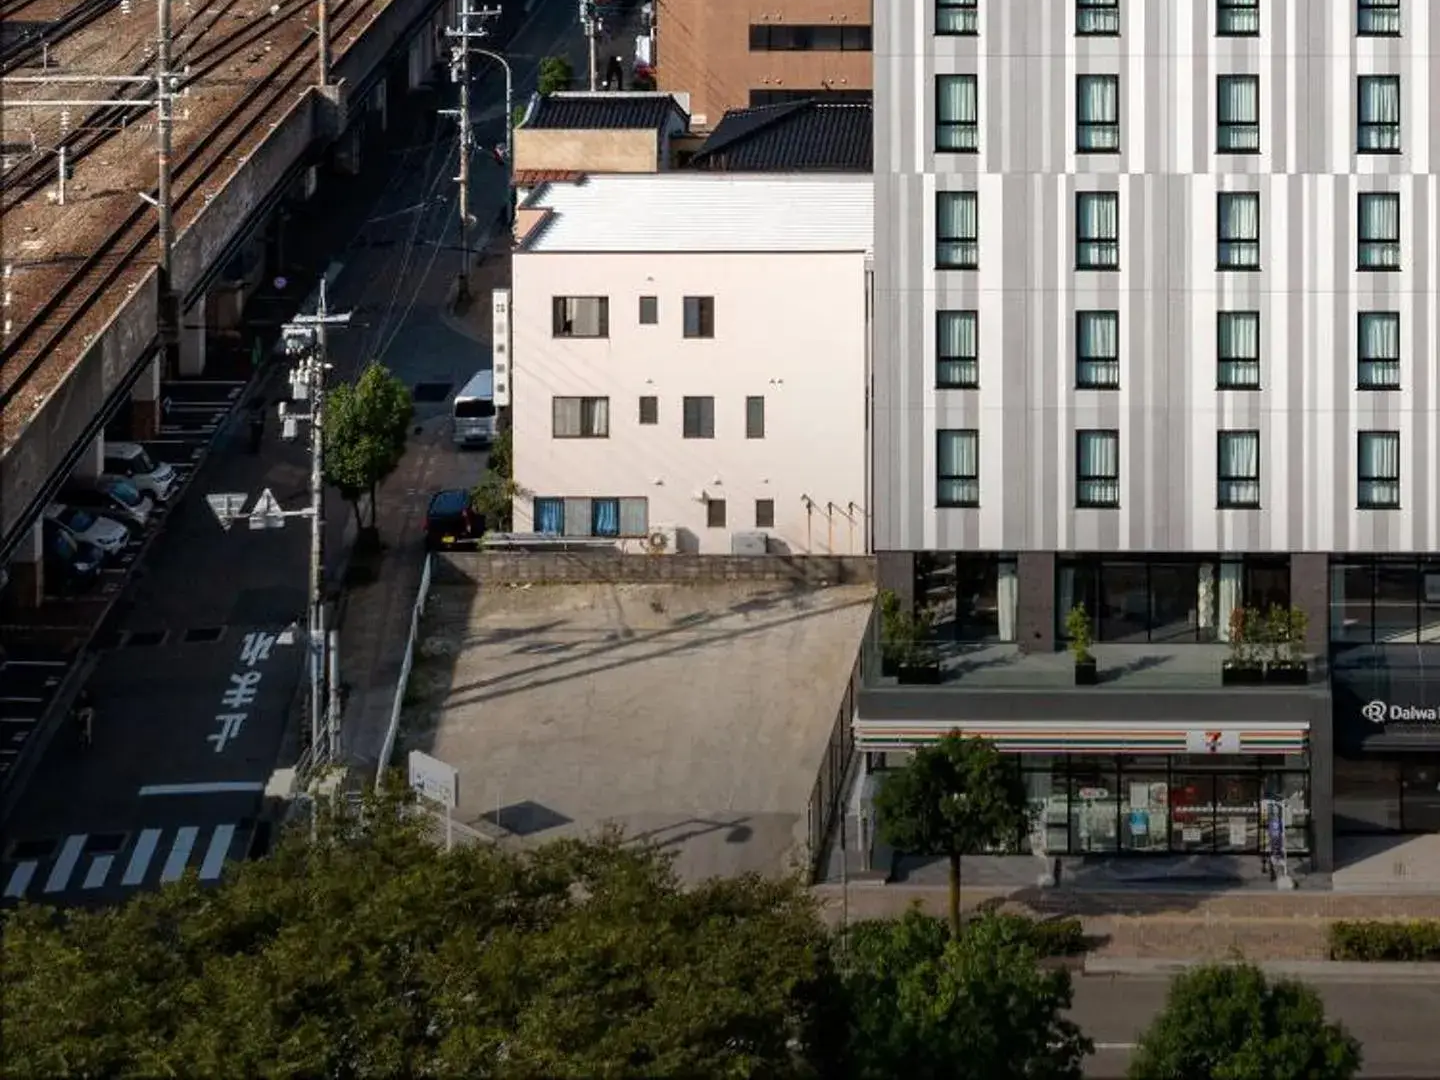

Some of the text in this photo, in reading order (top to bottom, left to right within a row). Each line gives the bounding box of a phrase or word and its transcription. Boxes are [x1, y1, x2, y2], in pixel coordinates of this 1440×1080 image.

[207, 631, 276, 753] 止まれ
[1390, 704, 1436, 721] Daiwa
